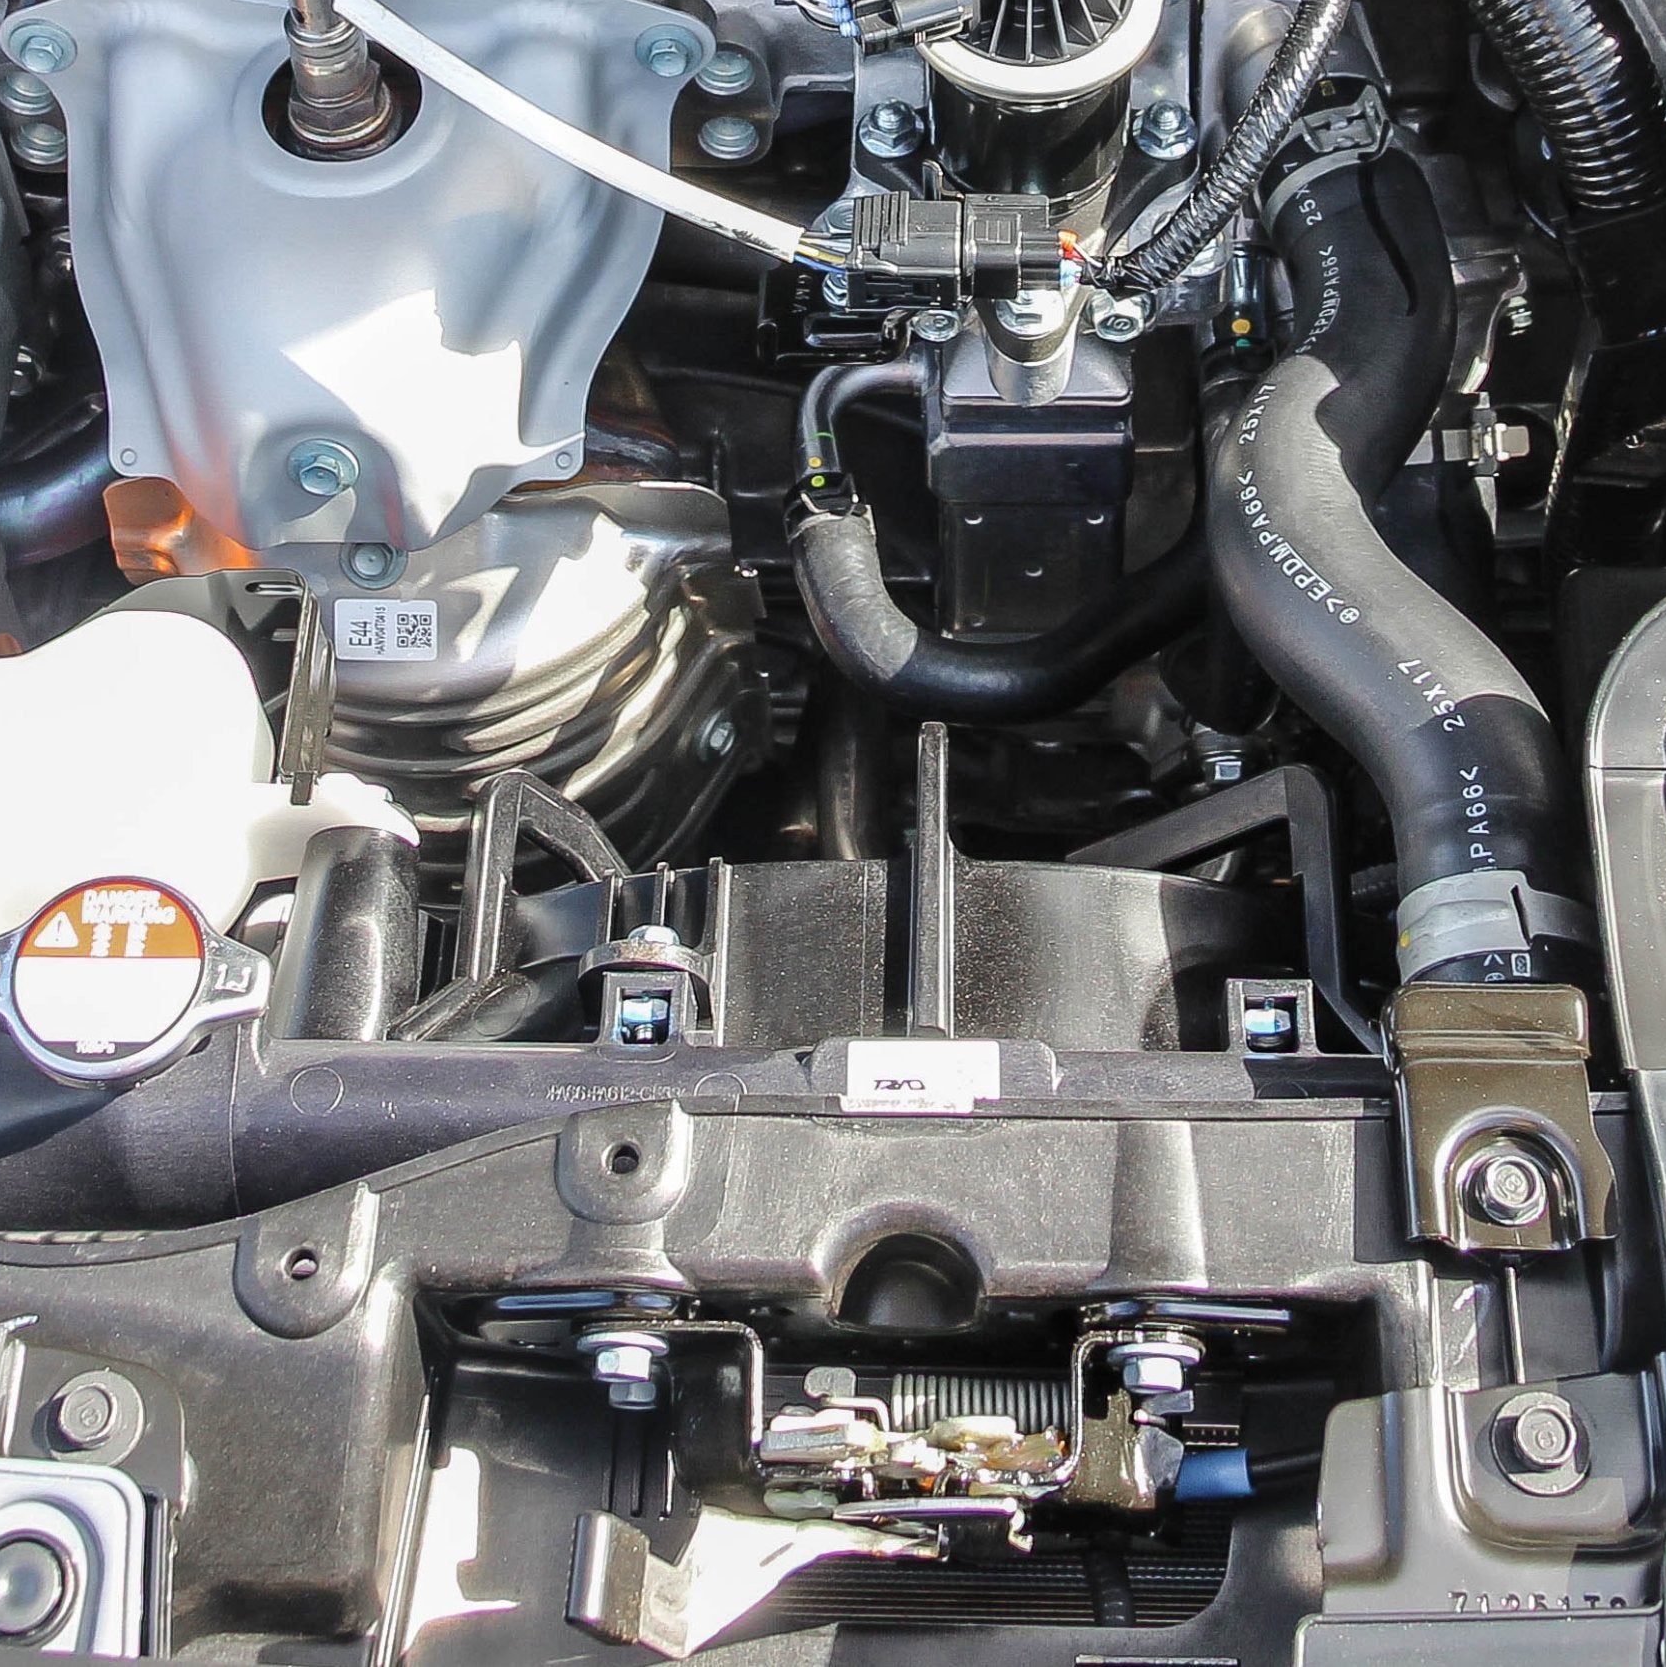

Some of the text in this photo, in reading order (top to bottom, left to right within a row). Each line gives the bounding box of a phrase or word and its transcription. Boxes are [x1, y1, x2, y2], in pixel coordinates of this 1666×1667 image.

[1238, 382, 1277, 446] 25X17
[348, 621, 373, 647] E44
[1397, 658, 1466, 733] 25X17
